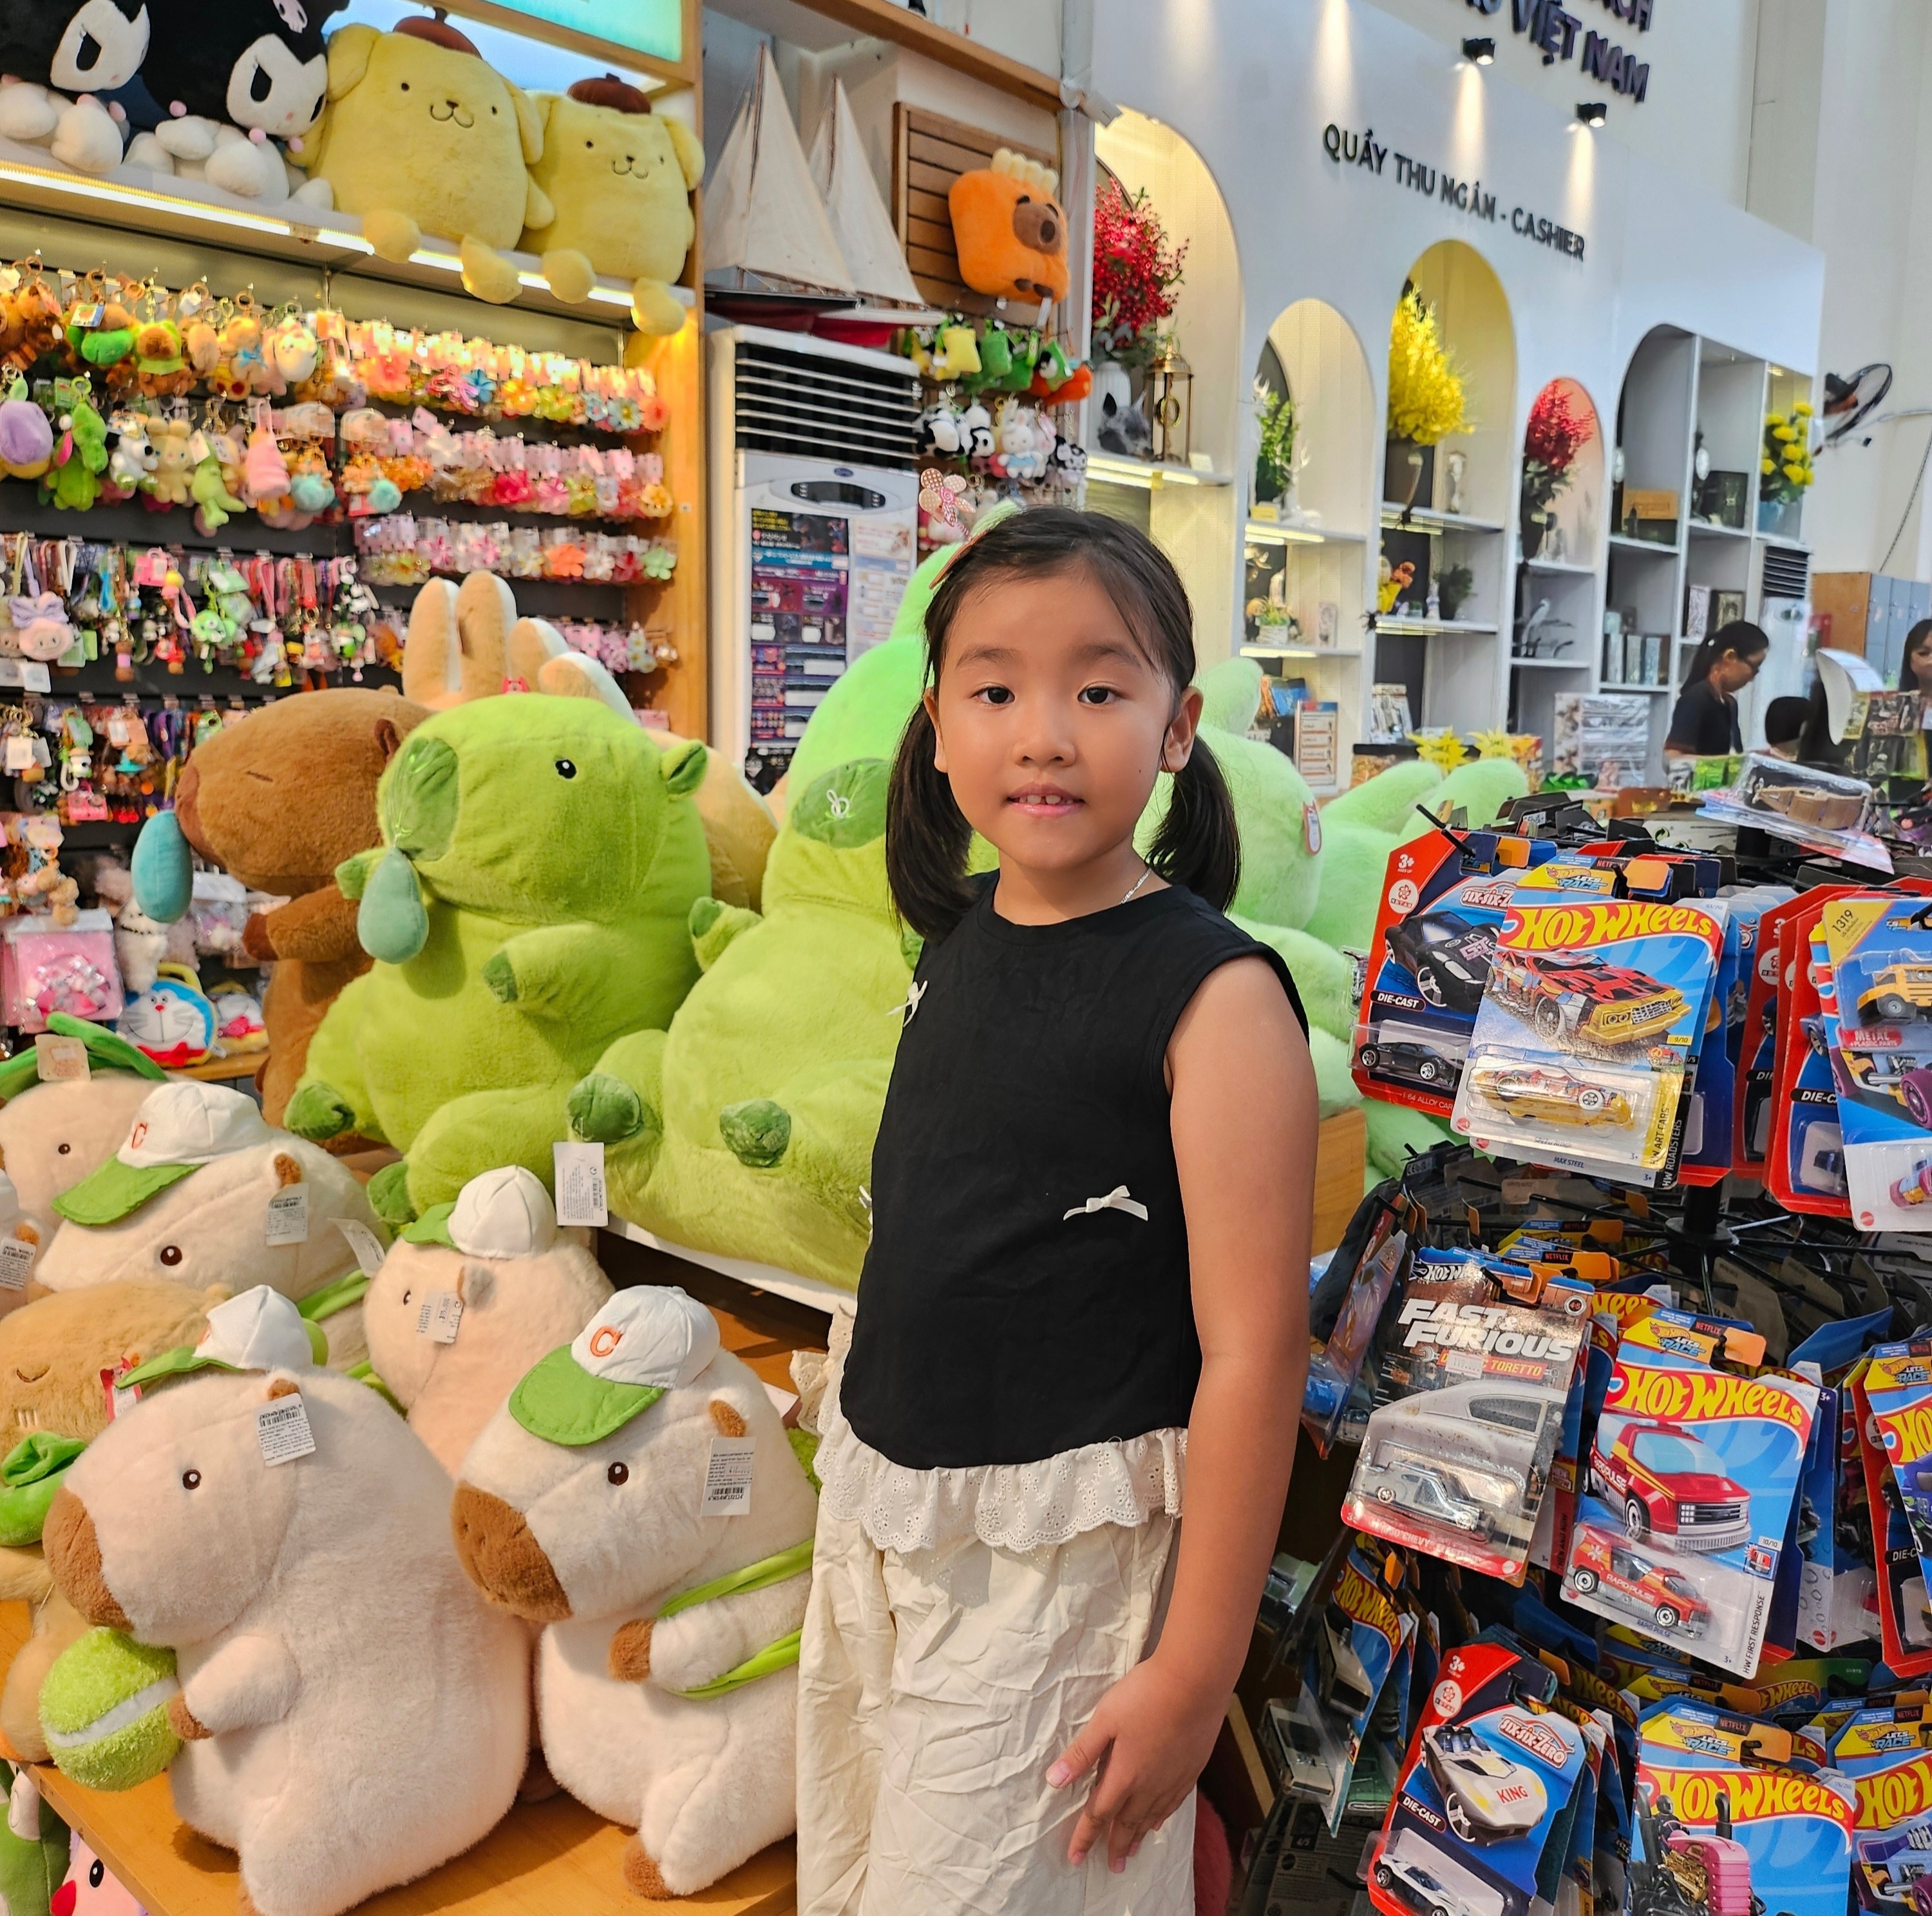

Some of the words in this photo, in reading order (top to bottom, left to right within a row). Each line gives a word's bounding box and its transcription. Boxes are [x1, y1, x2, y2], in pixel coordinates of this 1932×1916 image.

[1581, 30, 1650, 104] NAM
[1394, 153, 1435, 196] THU
[1441, 173, 1496, 222] NGÂN
[1511, 207, 1585, 262] CASHIER
[1399, 854, 1415, 869] 3+
[1559, 878, 1607, 891] RACE
[1832, 909, 1853, 933] 1319
[1377, 992, 1419, 1009] DIE-CAST
[1854, 1030, 1889, 1041] METAL
[1417, 1097, 1437, 1106] ALLOY
[131, 1122, 148, 1149] C
[1654, 1132, 1665, 1149] ART
[1660, 1107, 1669, 1130] CARS
[1666, 1119, 1682, 1170] ROADSTERS
[1553, 1157, 1567, 1166] MAX
[1567, 1160, 1584, 1168] STEEL
[1663, 1174, 1671, 1187] HW
[1546, 1253, 1569, 1261] NETFLIX
[1397, 1298, 1509, 1331] FAST
[1499, 1316, 1519, 1331] &
[1696, 1322, 1722, 1335] NETFLIX
[590, 1325, 622, 1358] C
[1403, 1321, 1577, 1361] FURIOUS
[1662, 1340, 1707, 1356] RACE
[1492, 1359, 1542, 1376] TORETTO
[1899, 1371, 1930, 1383] RACE
[1820, 1392, 1831, 1402] 3+
[1607, 1467, 1627, 1494] PULSE
[1401, 1530, 1430, 1547] CHEVY
[1763, 1539, 1777, 1548] 10/10
[1607, 1573, 1629, 1590] RAPID
[1629, 1584, 1655, 1603] PULSE
[1750, 1596, 1765, 1633] RESPONSE
[1637, 1619, 1653, 1630] RAPID
[1653, 1626, 1672, 1638] PULSE
[1748, 1635, 1758, 1658] FIRST
[1449, 1655, 1465, 1671] 3+
[1723, 1655, 1732, 1664] 3+
[1743, 1660, 1751, 1674] HW
[1897, 1710, 1919, 1719] NETFLIX
[1720, 1718, 1748, 1732] NETFLIX
[1683, 1738, 1736, 1756] RACE
[1875, 1735, 1915, 1749] RACE
[1497, 1785, 1529, 1805] KING
[1402, 1795, 1443, 1828] DIE-CAST
